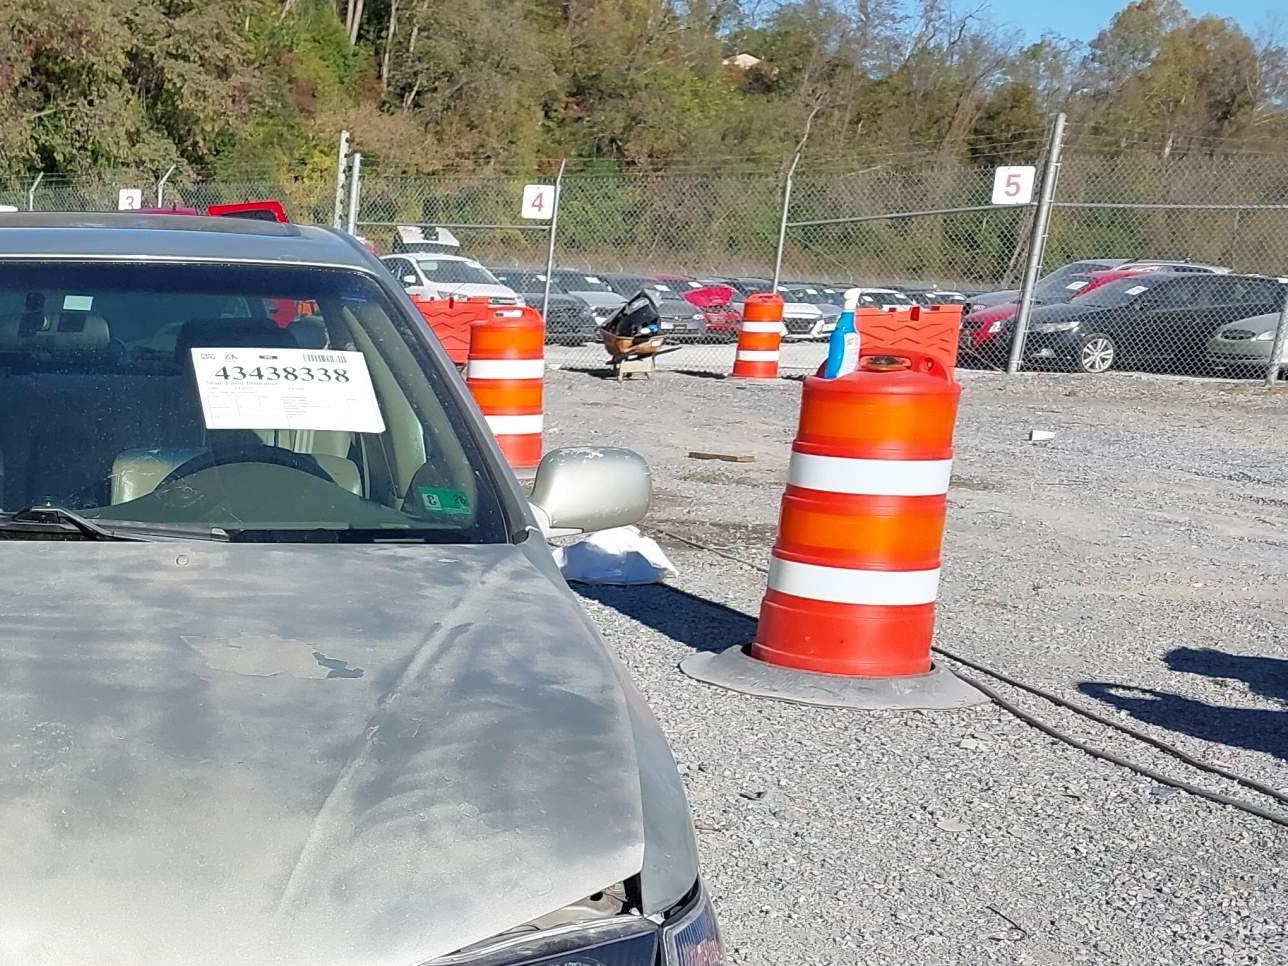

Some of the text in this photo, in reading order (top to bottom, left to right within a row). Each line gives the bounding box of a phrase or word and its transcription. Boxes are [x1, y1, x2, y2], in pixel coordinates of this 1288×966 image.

[1005, 174, 1021, 197] 5
[531, 192, 544, 212] 4
[215, 366, 350, 383] 43438338
